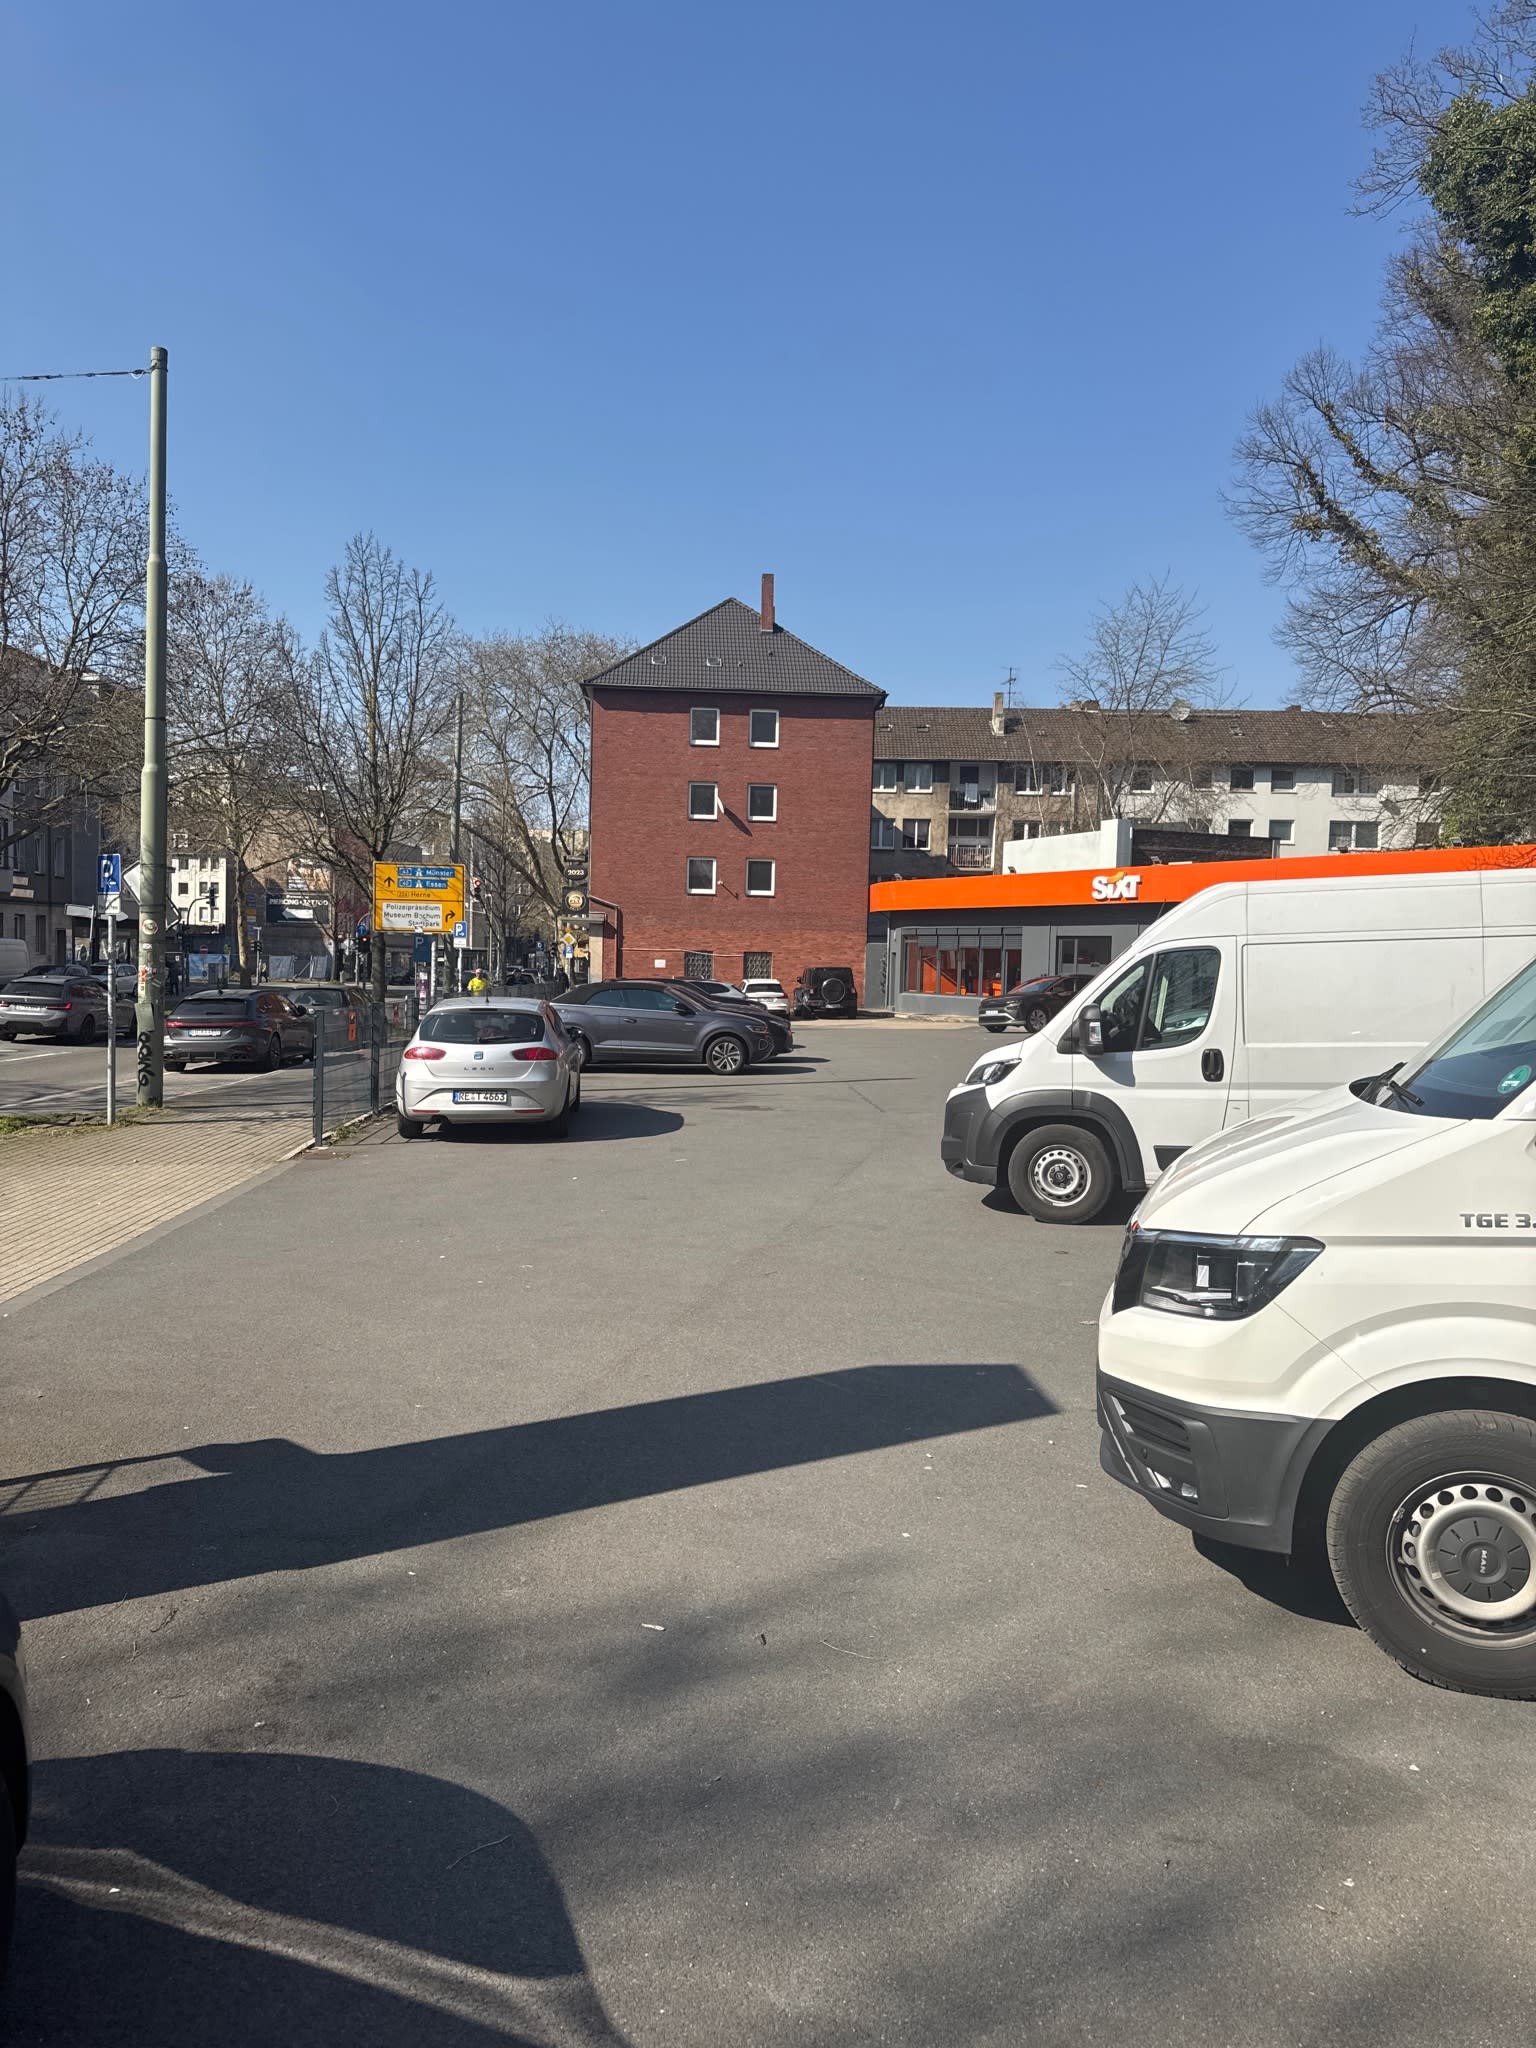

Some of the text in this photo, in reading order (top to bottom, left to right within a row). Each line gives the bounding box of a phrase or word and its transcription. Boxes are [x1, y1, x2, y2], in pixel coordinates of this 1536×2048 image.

[101, 859, 113, 889] P
[425, 868, 453, 877] Münster
[411, 890, 431, 898] Herne
[386, 903, 441, 912] Polizeipräsidium
[455, 923, 463, 936] P
[415, 936, 424, 949] P
[1459, 1213, 1509, 1229] TGE
[1479, 1549, 1488, 1575] MAN
